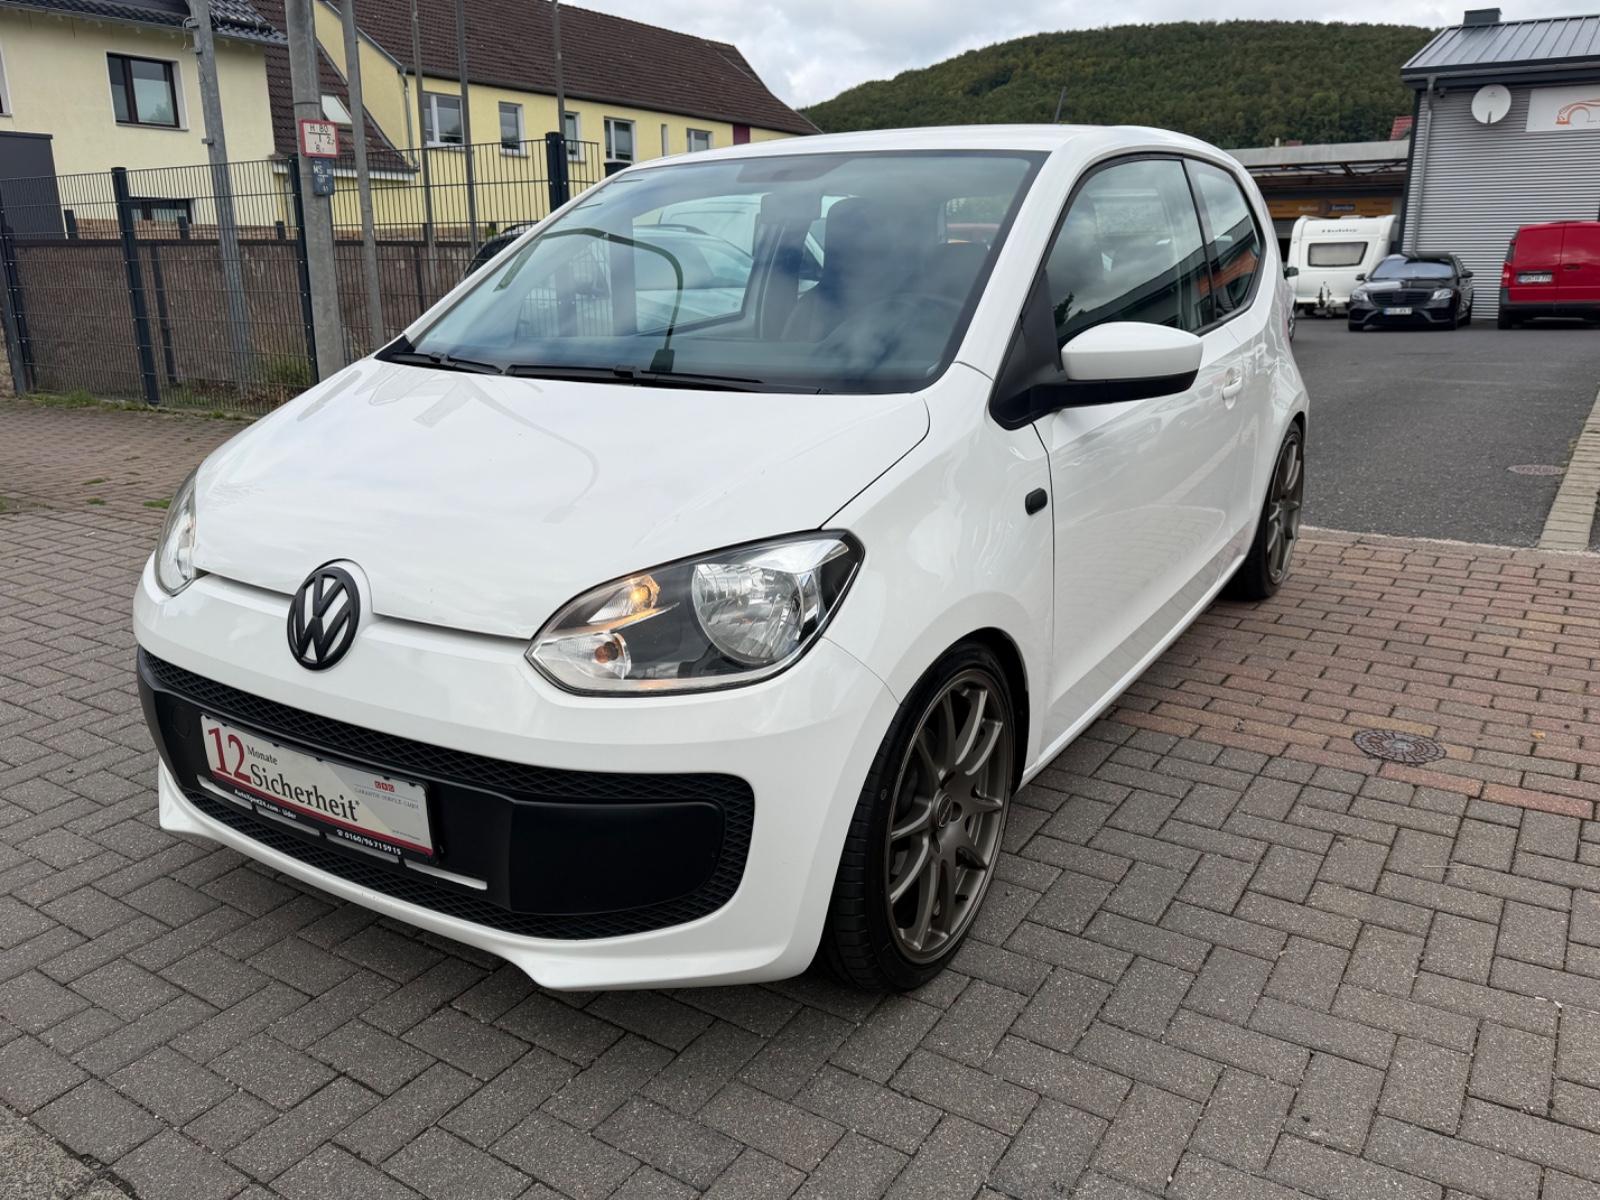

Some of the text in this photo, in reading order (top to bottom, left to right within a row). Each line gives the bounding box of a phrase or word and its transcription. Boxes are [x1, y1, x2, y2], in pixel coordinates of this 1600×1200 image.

[287, 564, 361, 671] VW
[208, 727, 252, 784] 12
[246, 745, 278, 766] Monate
